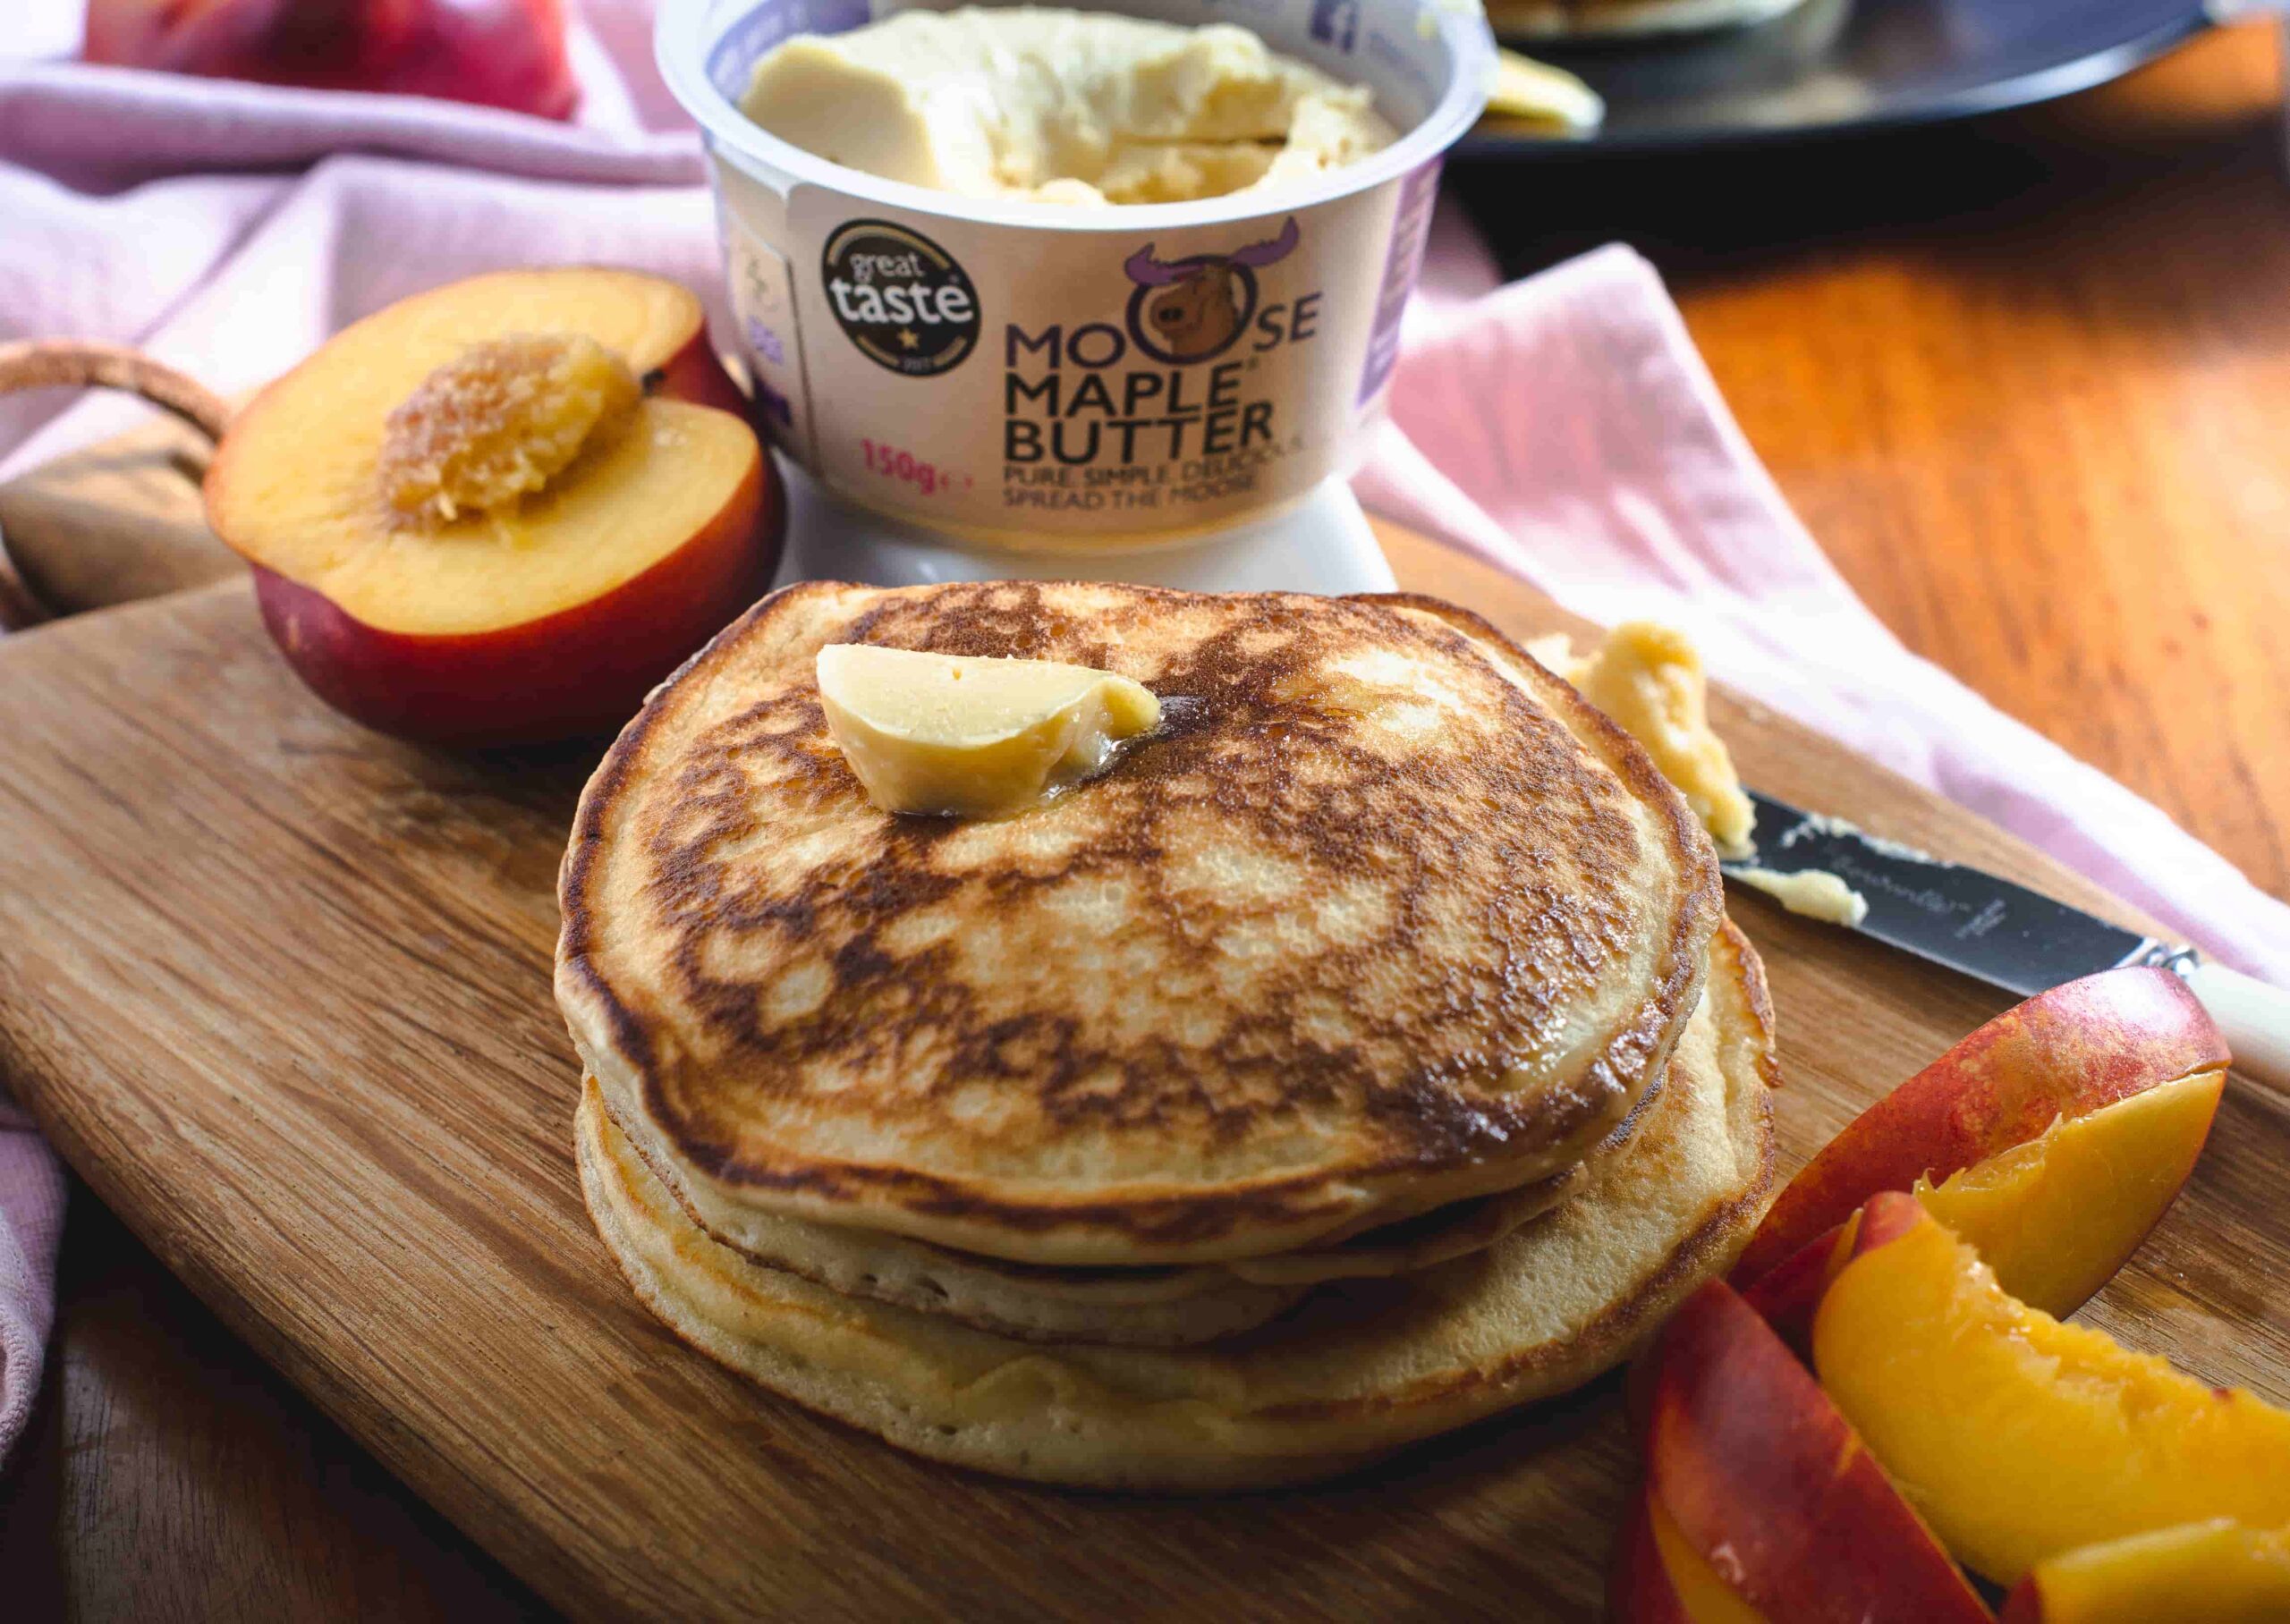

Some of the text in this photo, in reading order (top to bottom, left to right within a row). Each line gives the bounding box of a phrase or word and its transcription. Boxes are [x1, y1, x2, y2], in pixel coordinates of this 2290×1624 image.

[851, 253, 926, 283] great
[829, 276, 974, 324] taste
[1005, 362, 1243, 418] MAPLE
[1005, 402, 1273, 464] BUTTER
[860, 437, 937, 497] 150g
[1003, 487, 1106, 511] SPREAD
[1111, 490, 1161, 509] THE
